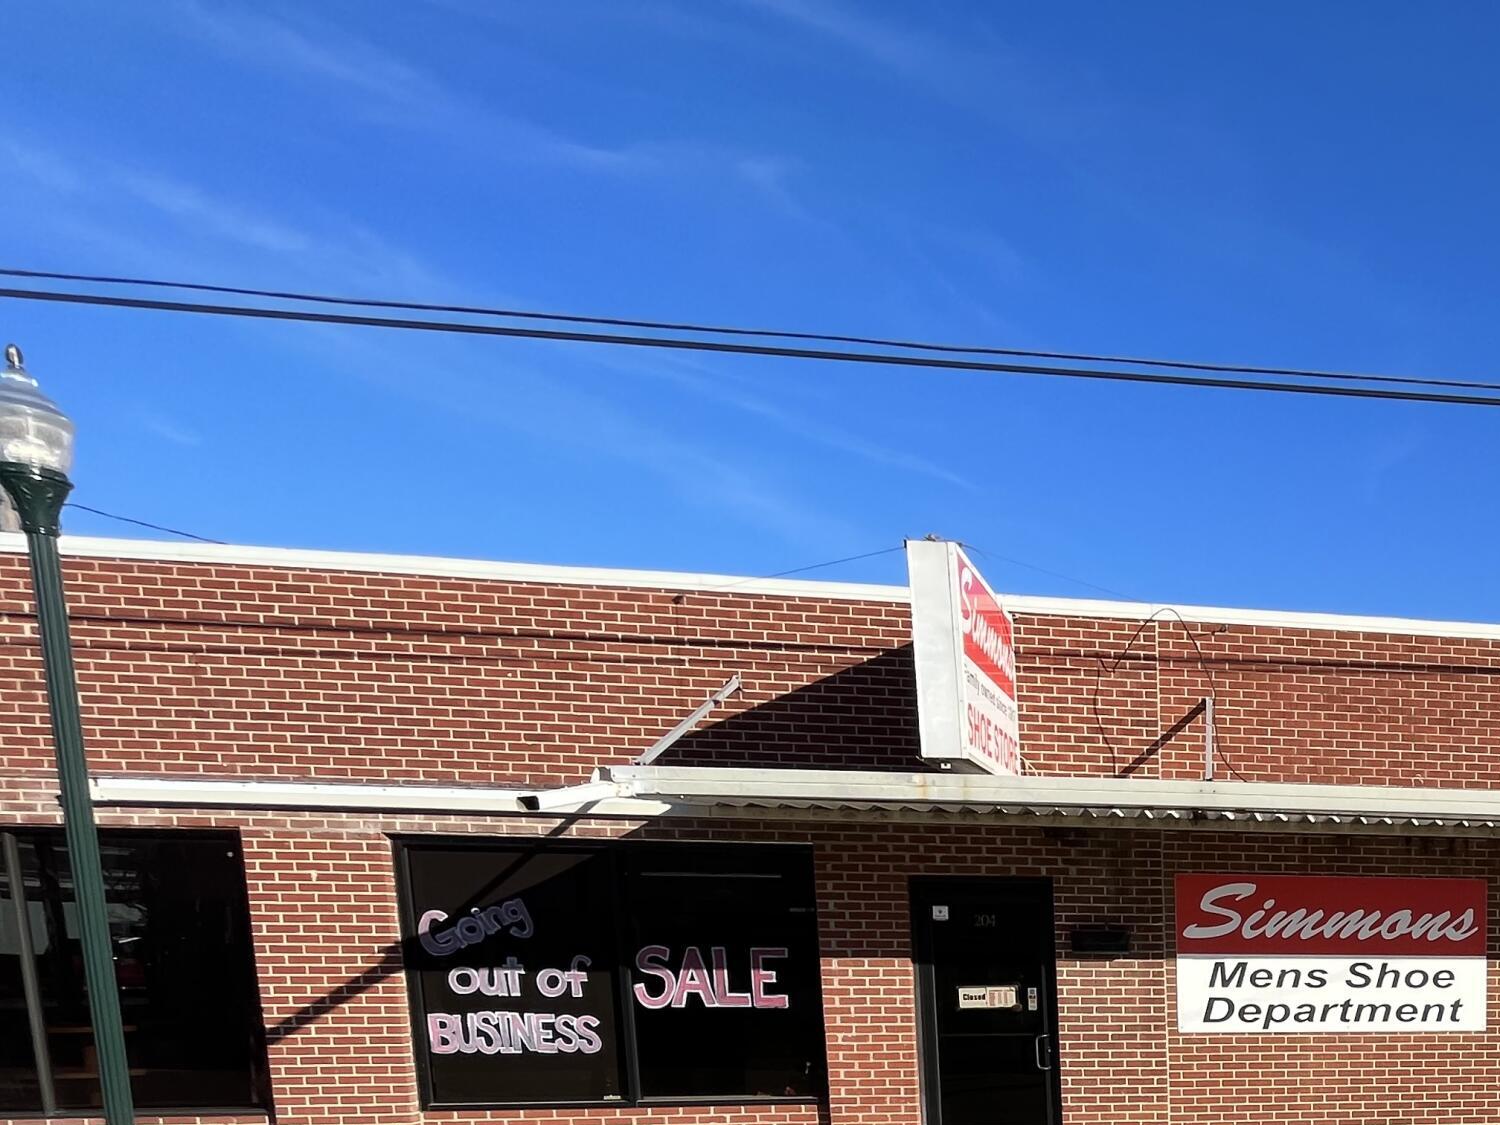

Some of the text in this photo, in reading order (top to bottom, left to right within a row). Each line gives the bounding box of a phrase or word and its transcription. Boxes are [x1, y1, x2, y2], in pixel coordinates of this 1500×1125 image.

[961, 566, 1014, 682] Simmons
[968, 702, 1018, 775] SHOE STORE
[417, 898, 534, 957] Going
[1182, 882, 1479, 942] Simmons
[536, 955, 593, 998] of
[633, 945, 790, 1010] SALE
[962, 993, 986, 1001] Closed
[1208, 961, 1456, 989] Mens Shoe
[427, 1010, 603, 1055] BUSINESS
[1202, 996, 1464, 1030] Department
